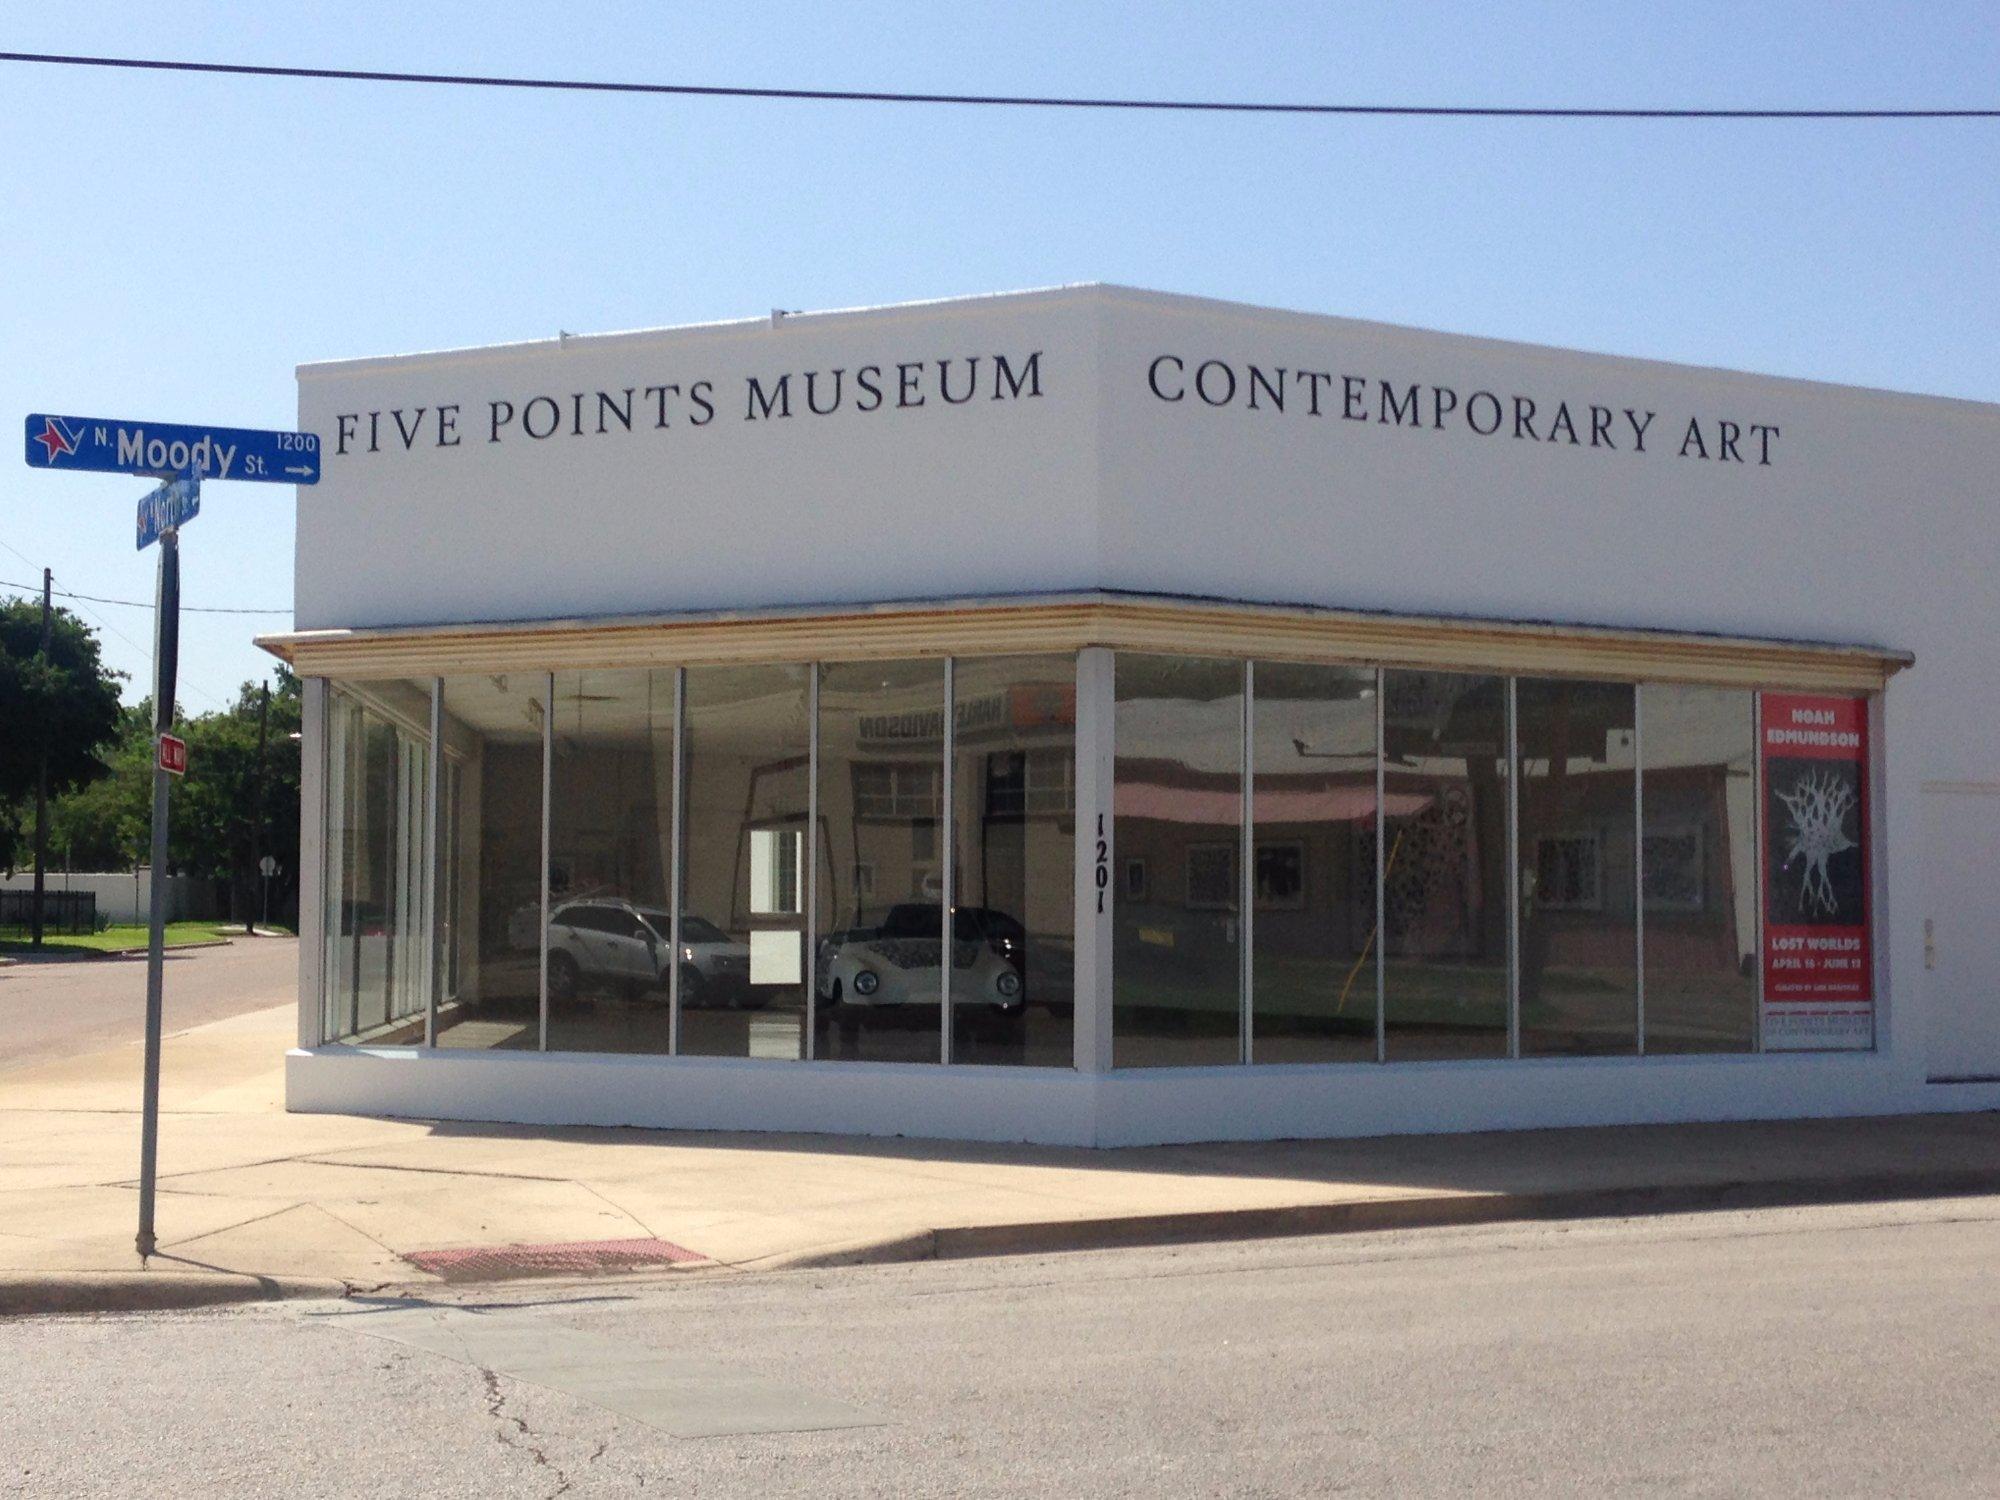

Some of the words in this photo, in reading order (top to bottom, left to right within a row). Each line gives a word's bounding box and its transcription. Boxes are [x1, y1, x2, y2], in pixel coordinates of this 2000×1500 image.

[335, 404, 461, 456] FIVE
[488, 380, 716, 444] POINTS
[744, 350, 1044, 421] MUSEUM
[1148, 354, 1656, 452] CONTEMPORARY
[1678, 416, 1781, 466] ART
[277, 433, 316, 451] 1200
[94, 426, 113, 447] N.
[117, 428, 237, 480] Moody
[244, 454, 269, 475] St.
[1791, 708, 1836, 726] NOAH
[1766, 728, 1860, 748] EDMUNDSON
[1095, 813, 1108, 914] 1201
[1771, 937, 1804, 951] LOST
[1806, 937, 1861, 951] WORLDS
[1772, 957, 1802, 969] APRIL
[1823, 957, 1848, 969] JUNE
